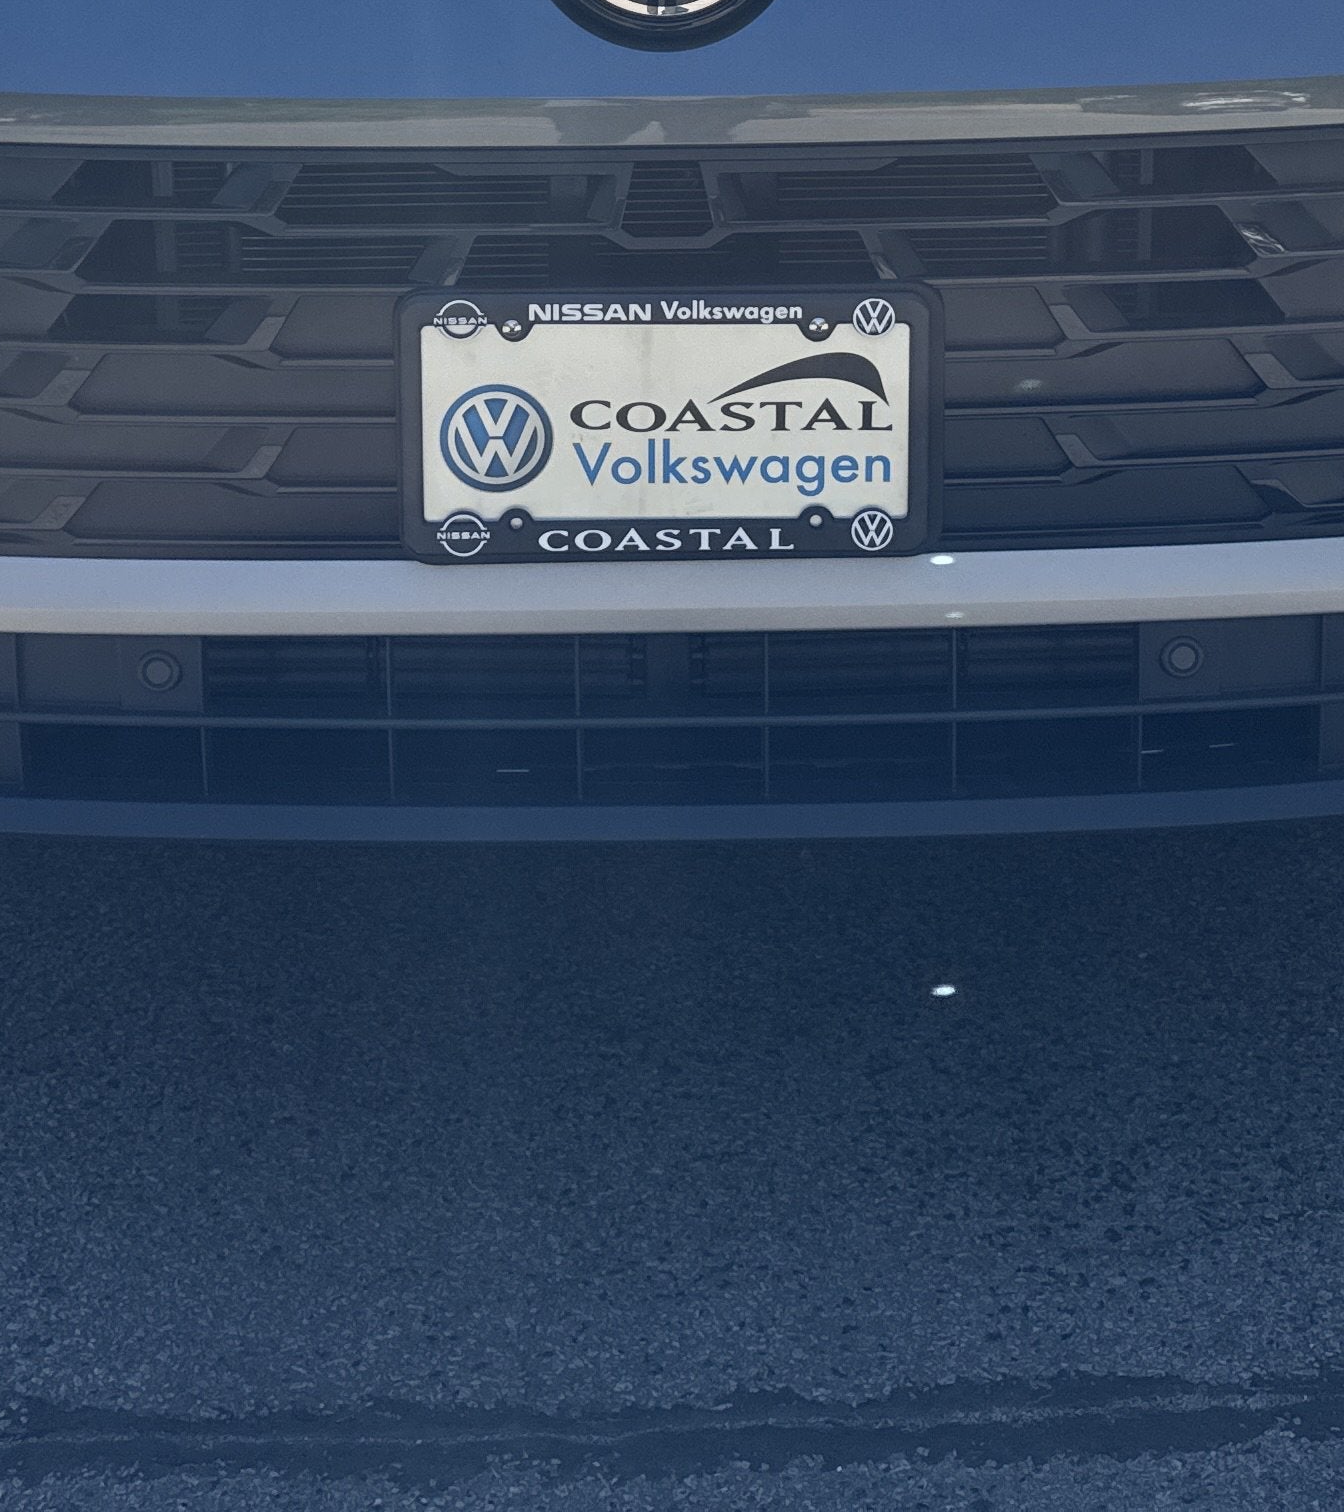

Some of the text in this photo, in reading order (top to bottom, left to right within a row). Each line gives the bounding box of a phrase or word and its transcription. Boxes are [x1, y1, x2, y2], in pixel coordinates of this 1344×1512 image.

[433, 316, 488, 325] NISSAN
[528, 300, 803, 324] NISSAN Volkswagen
[569, 397, 894, 433] COASTAL
[572, 438, 892, 497] Volkswagen
[436, 531, 491, 540] NISSAN
[537, 527, 795, 552] COASTAL
